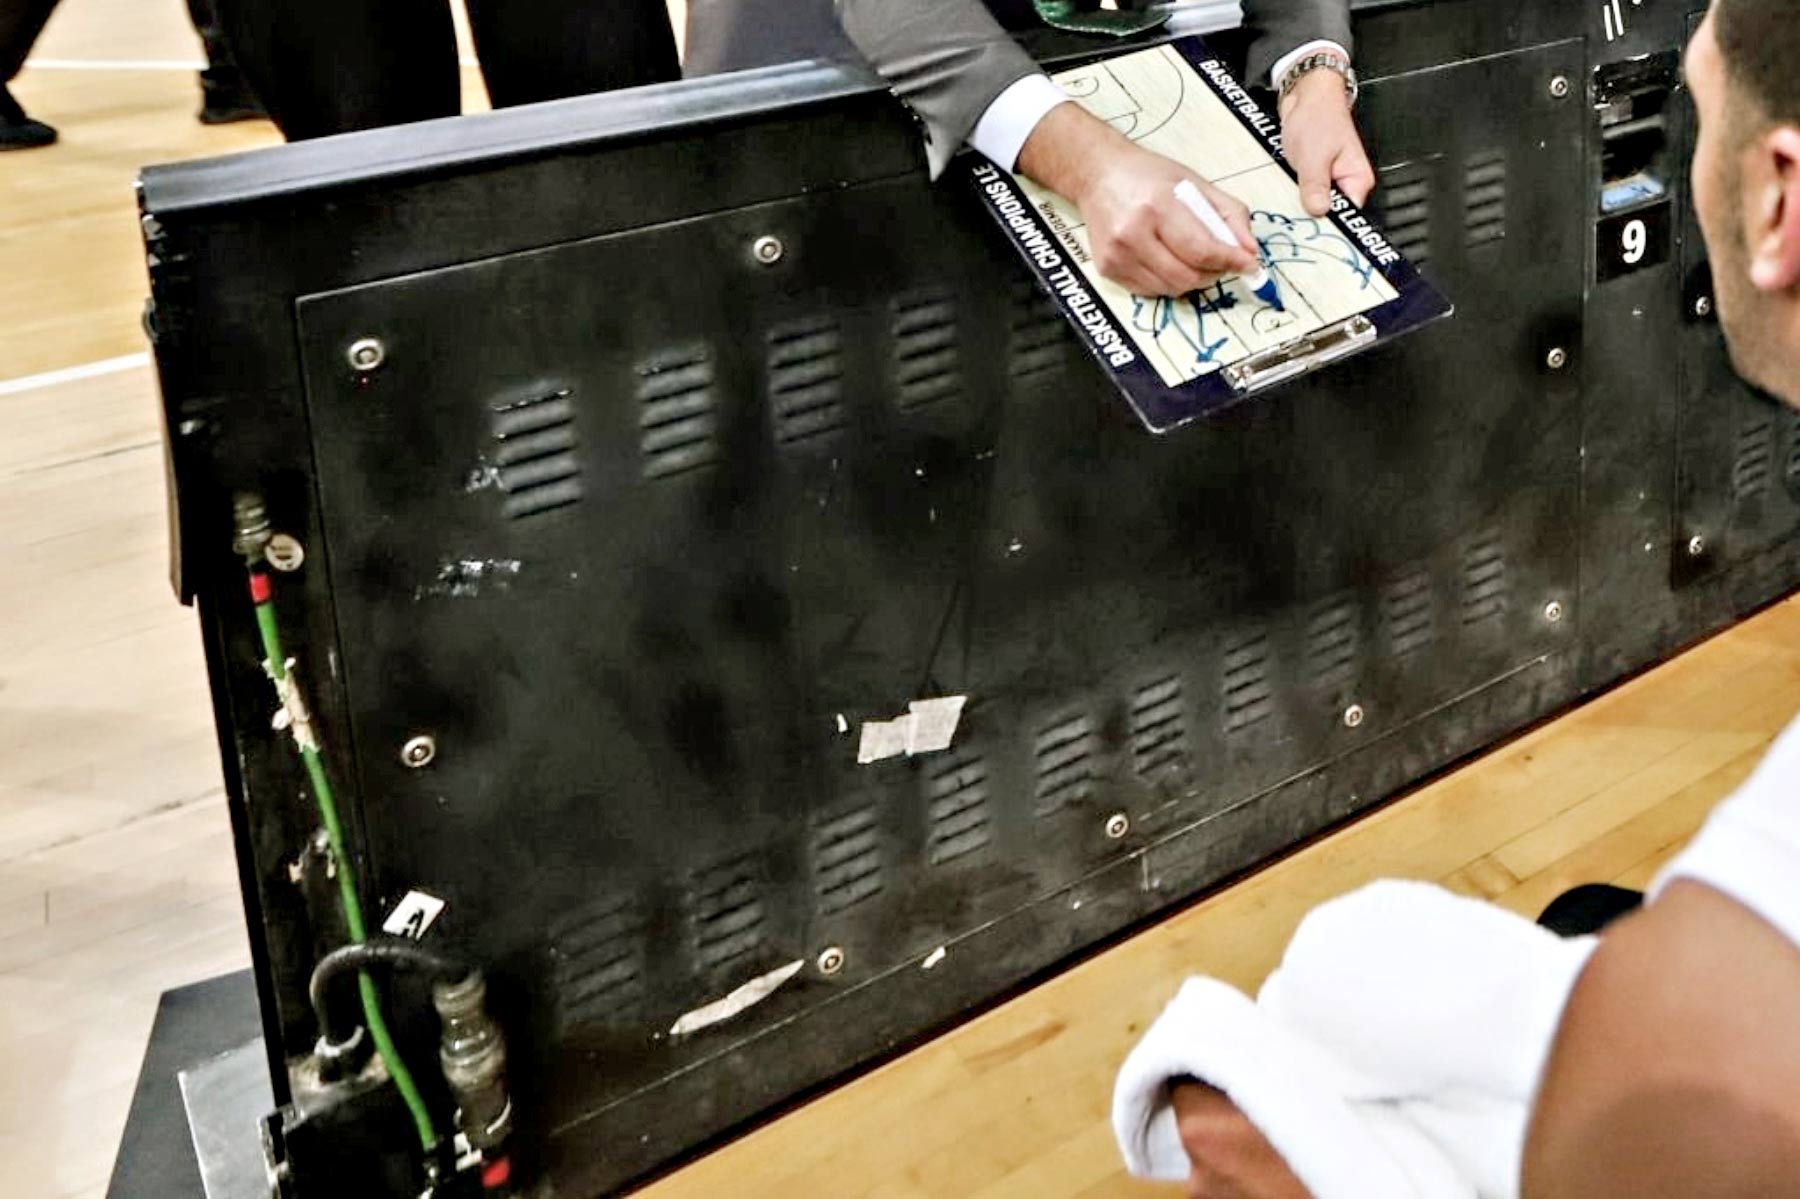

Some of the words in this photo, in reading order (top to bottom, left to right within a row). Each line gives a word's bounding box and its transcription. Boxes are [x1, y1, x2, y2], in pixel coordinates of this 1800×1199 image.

[986, 180, 1059, 271] CHAMPIONS
[1339, 207, 1400, 267] LEAGUE
[1621, 219, 1647, 264] 9
[1048, 262, 1135, 368] BASKETBALL
